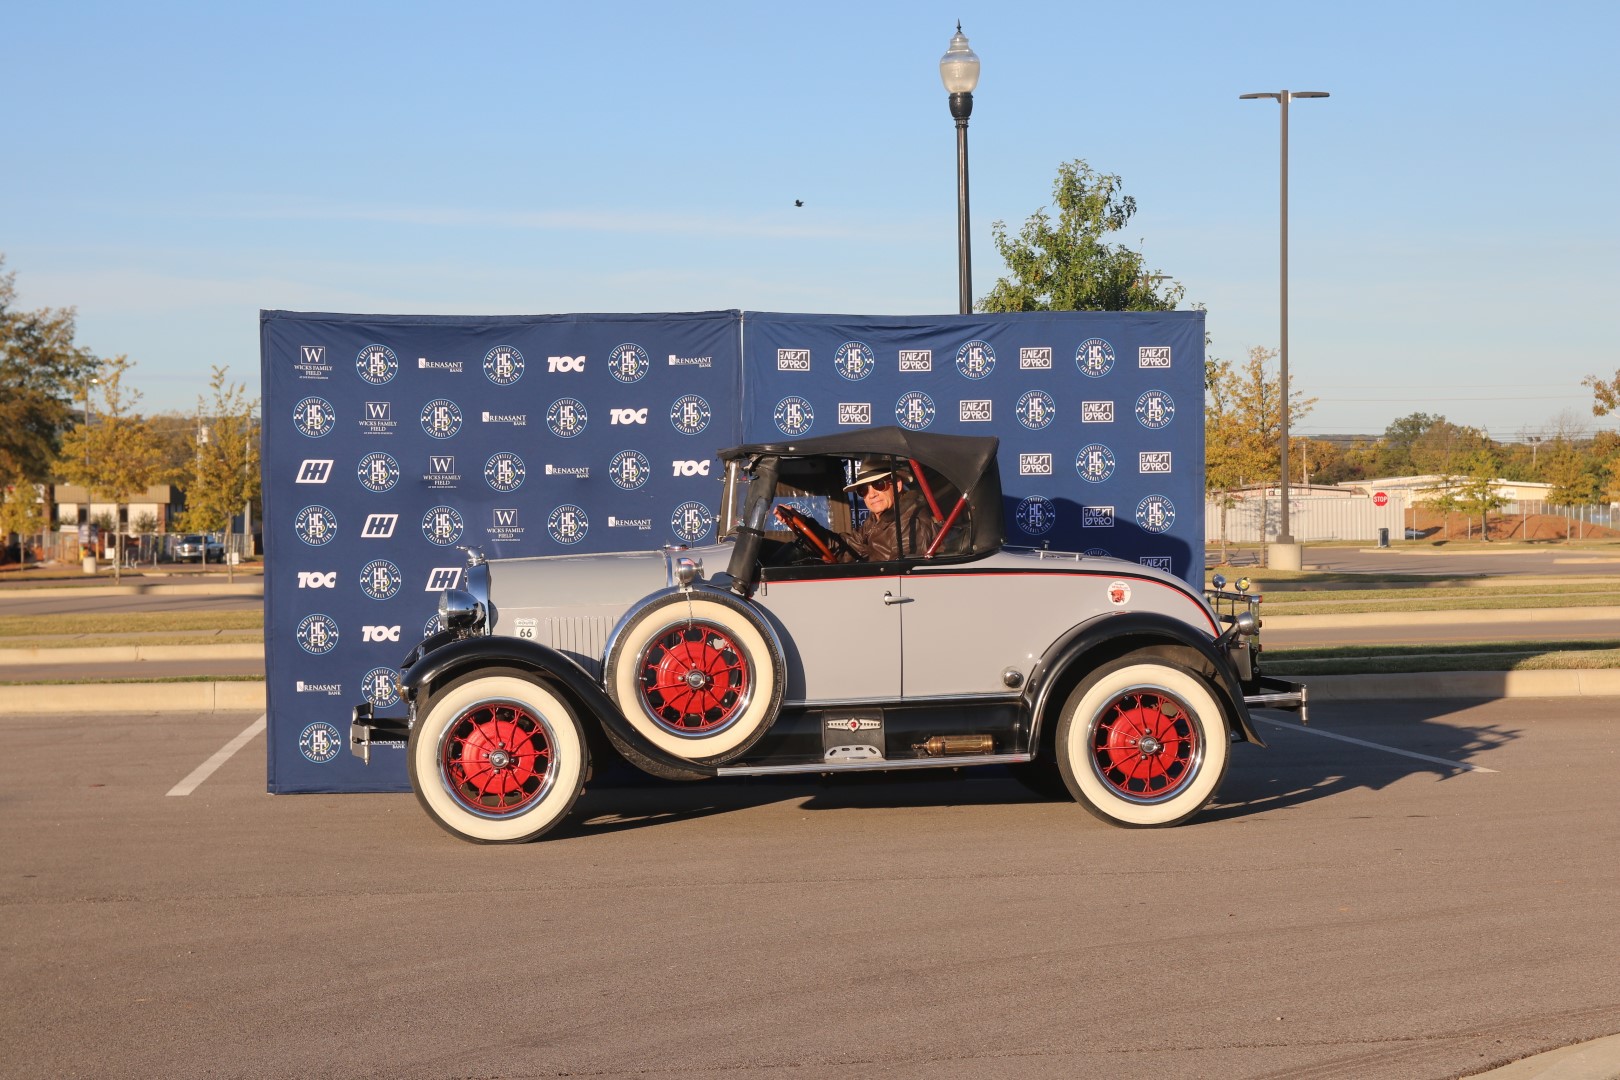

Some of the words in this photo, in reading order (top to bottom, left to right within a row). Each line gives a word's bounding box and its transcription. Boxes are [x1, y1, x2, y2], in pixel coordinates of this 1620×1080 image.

[303, 348, 323, 362] W
[784, 352, 807, 360] NEXT
[1027, 350, 1049, 358] NEXT
[1145, 349, 1168, 357] NEXT
[548, 356, 586, 372] TOC
[789, 360, 808, 368] PRO
[910, 361, 929, 369] PRO
[1031, 358, 1049, 367] PRO
[1150, 358, 1168, 366] PRO
[368, 404, 387, 418] W
[1089, 403, 1111, 412] NEXT
[610, 408, 648, 424] TOC
[1094, 412, 1112, 421] PRO
[1025, 456, 1049, 464] NEXT
[1146, 454, 1168, 462] NEXT
[432, 458, 452, 472] W
[672, 460, 710, 476] TOC
[1031, 465, 1049, 473] PRO
[1151, 463, 1168, 471] PRO
[496, 511, 515, 525] W
[1094, 517, 1111, 525] PRO
[298, 572, 336, 588] TOC
[362, 626, 400, 642] TOC
[520, 628, 532, 637] 66
